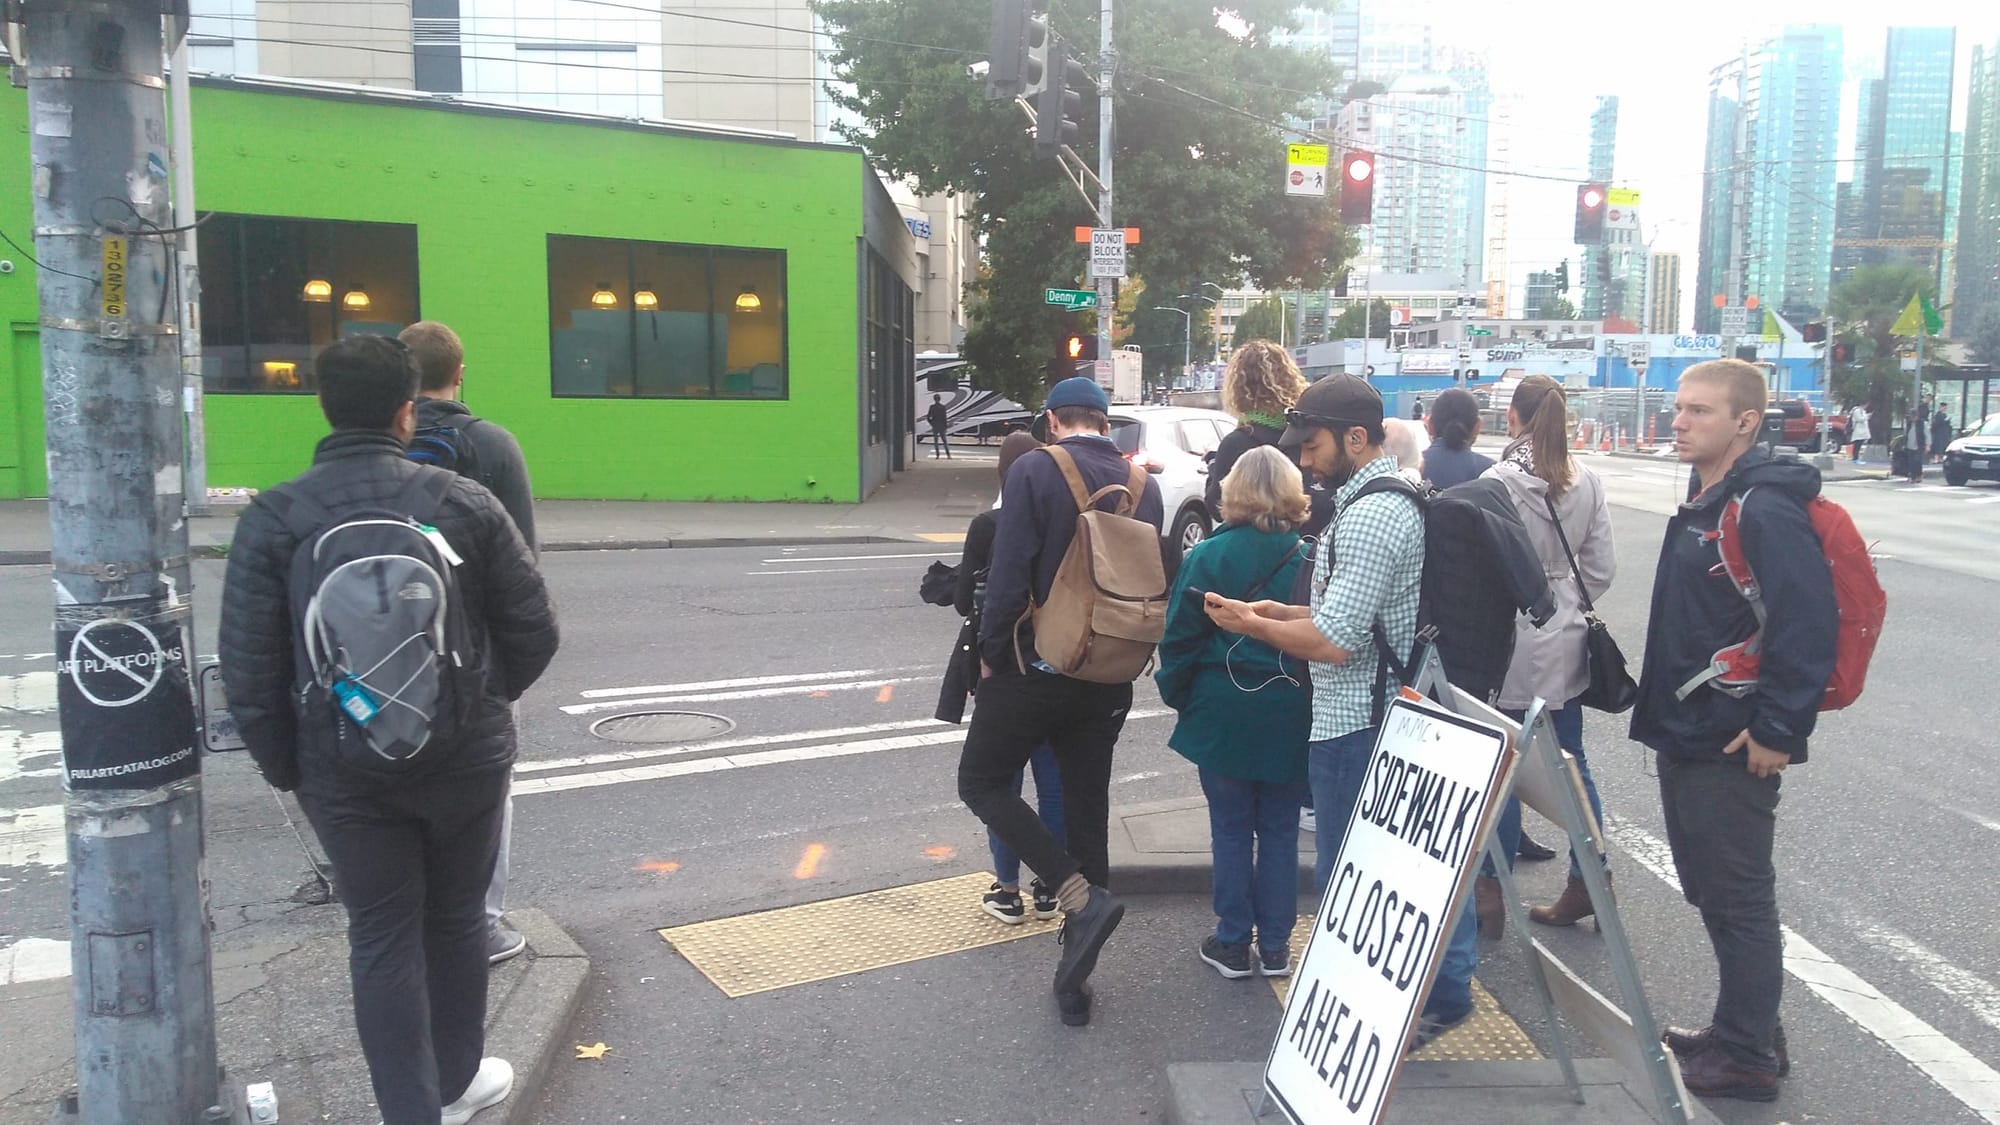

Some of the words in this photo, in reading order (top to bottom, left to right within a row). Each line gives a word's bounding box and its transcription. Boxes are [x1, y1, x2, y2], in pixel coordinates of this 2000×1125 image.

[1094, 233, 1105, 244] DO
[1107, 233, 1122, 244] NOT
[1095, 246, 1122, 256] BLOCK
[106, 240, 122, 314] 1302736
[1049, 291, 1077, 305] Denny
[57, 660, 81, 674] ART
[84, 646, 183, 673] PLATFORMS
[71, 747, 193, 780] FULLARTCATALOG.COM
[1361, 750, 1480, 869] SIDEWALK
[1326, 862, 1430, 992] CLOSED
[1289, 978, 1381, 1114] AHEAD
